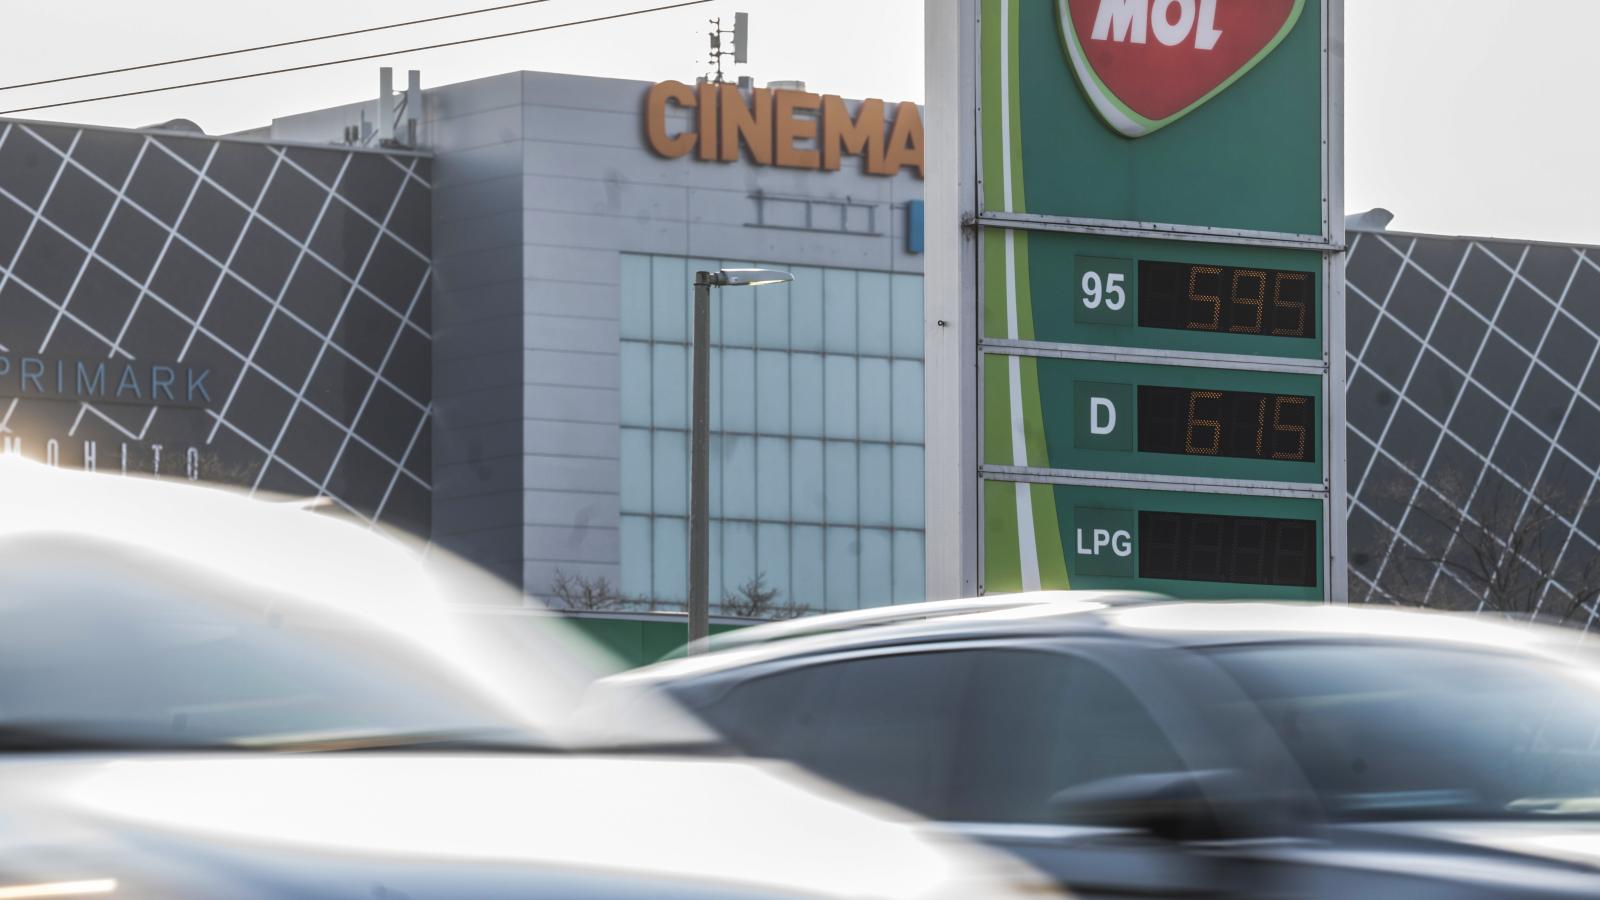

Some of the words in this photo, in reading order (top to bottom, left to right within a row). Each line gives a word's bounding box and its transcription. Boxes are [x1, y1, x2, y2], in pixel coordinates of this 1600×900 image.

[1091, 0, 1223, 50] MOL
[645, 80, 924, 179] CINEMA
[1081, 271, 1126, 310] 95
[1186, 266, 1306, 336] 595
[1090, 396, 1117, 435] D
[1185, 391, 1306, 460] 615
[1076, 528, 1132, 557] LPG
